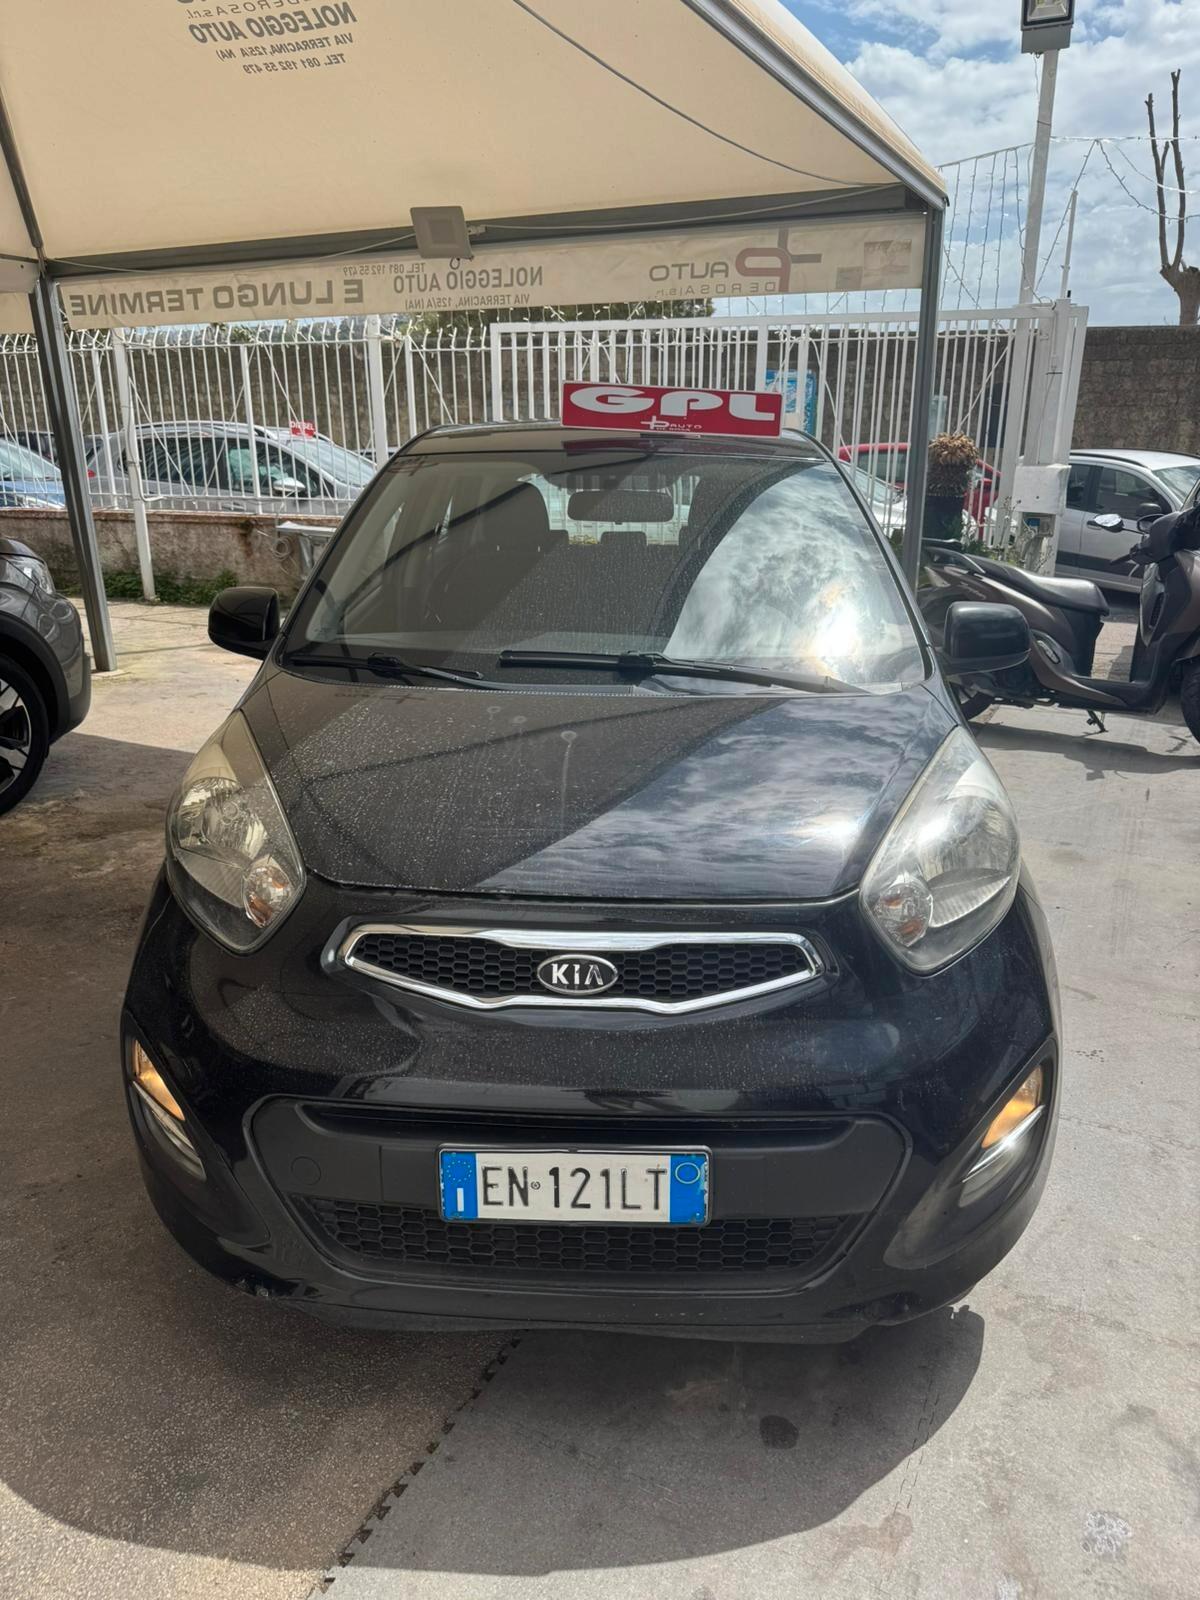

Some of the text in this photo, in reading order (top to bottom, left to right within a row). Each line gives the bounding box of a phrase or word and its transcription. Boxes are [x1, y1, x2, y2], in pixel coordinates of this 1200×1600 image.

[570, 386, 776, 421] GPL
[550, 963, 604, 986] KIA
[481, 1166, 668, 1211] EN 121LT
